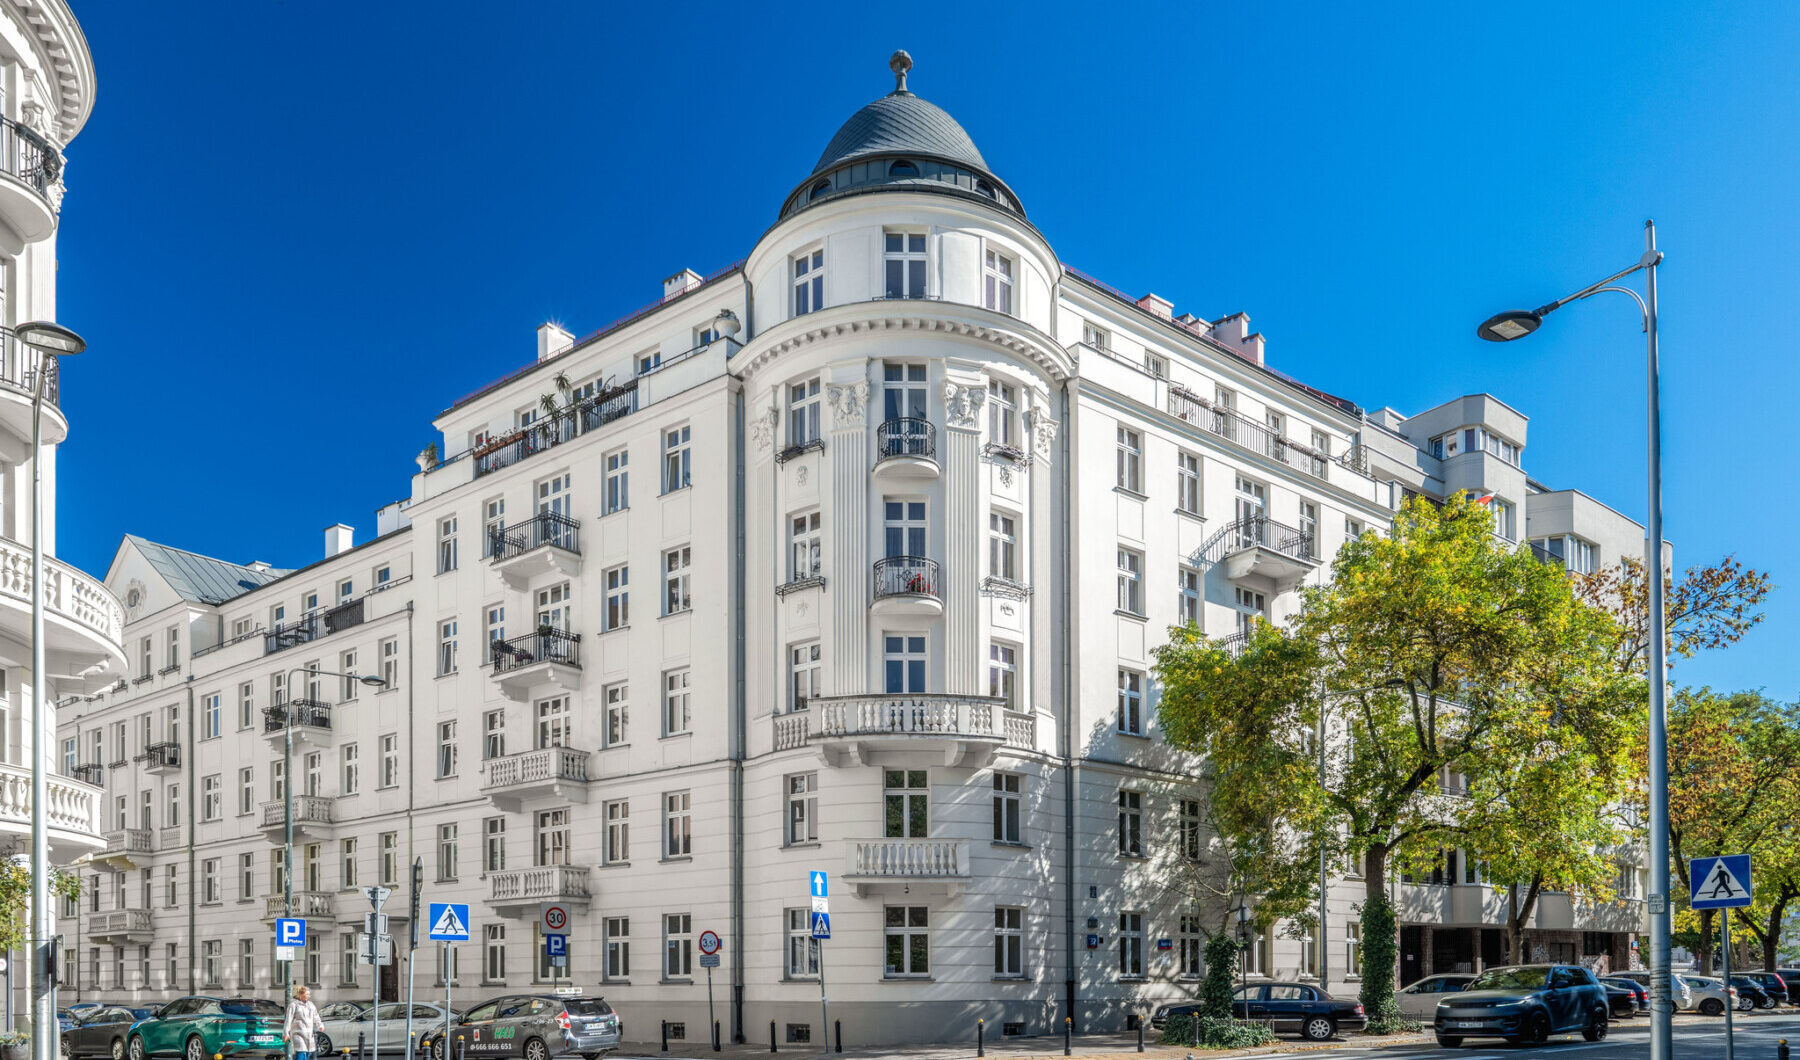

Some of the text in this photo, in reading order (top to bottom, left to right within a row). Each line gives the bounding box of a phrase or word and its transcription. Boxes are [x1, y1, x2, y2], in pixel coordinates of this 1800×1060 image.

[549, 912, 564, 924] 30
[283, 921, 300, 943] P
[551, 936, 562, 953] P
[494, 1026, 515, 1040] HALO
